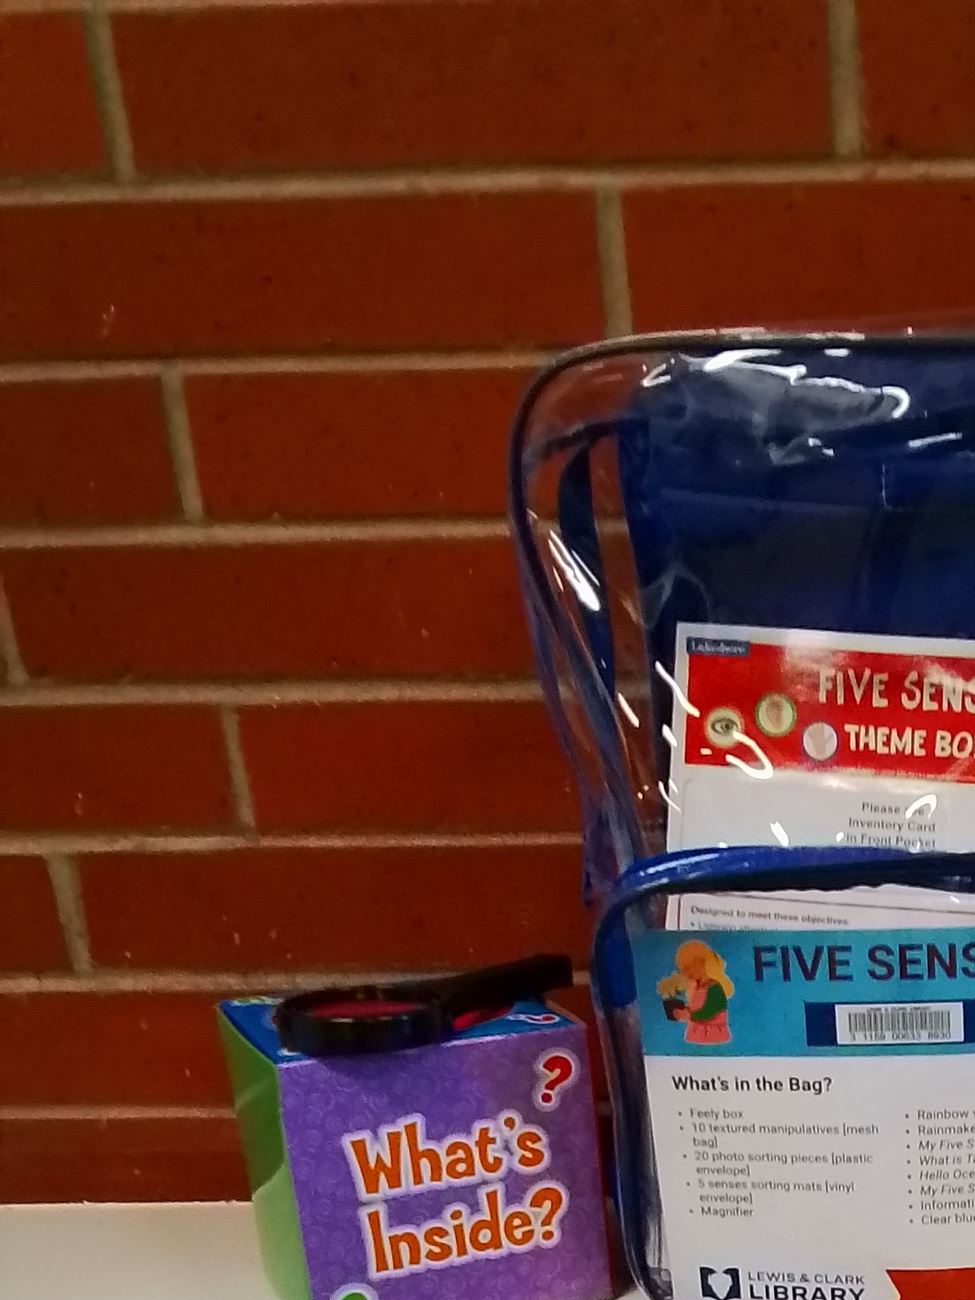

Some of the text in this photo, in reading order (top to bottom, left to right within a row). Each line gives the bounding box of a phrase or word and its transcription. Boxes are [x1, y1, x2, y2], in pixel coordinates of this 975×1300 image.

[819, 667, 889, 708] FIVE
[845, 725, 927, 756] THEME
[862, 802, 900, 813] Please
[849, 817, 936, 832] Inventory Card
[860, 834, 891, 846] Front
[896, 836, 936, 848] Pocket
[691, 905, 734, 917] Designed
[737, 909, 745, 917] to
[749, 911, 771, 920] meet
[753, 944, 853, 982] FIVE
[672, 1076, 832, 1095] What's in the Bag?
[690, 1108, 743, 1121] Feely box
[917, 1108, 969, 1121] Rainbow
[692, 1123, 879, 1137] 10 textured manipulatives [mesh
[693, 1137, 718, 1149] bag]
[918, 1139, 936, 1152] My
[939, 1139, 963, 1150] Five
[347, 1114, 547, 1196] What's
[695, 1152, 874, 1165] 20 photo sorting pieces [plastic
[919, 1154, 949, 1166] What
[953, 1153, 962, 1165] is
[696, 1166, 750, 1177] envelope]
[919, 1169, 949, 1181] Hello
[699, 1179, 854, 1193] 5 senses sorting mats [vinyl
[920, 1184, 937, 1197] My
[940, 1184, 964, 1195] Five
[700, 1193, 753, 1205] envelope]
[701, 1206, 753, 1219] Magnifier
[921, 1213, 952, 1225] Clear
[366, 1186, 564, 1274] Inside?
[749, 1271, 865, 1285] LEWIS & CLARK
